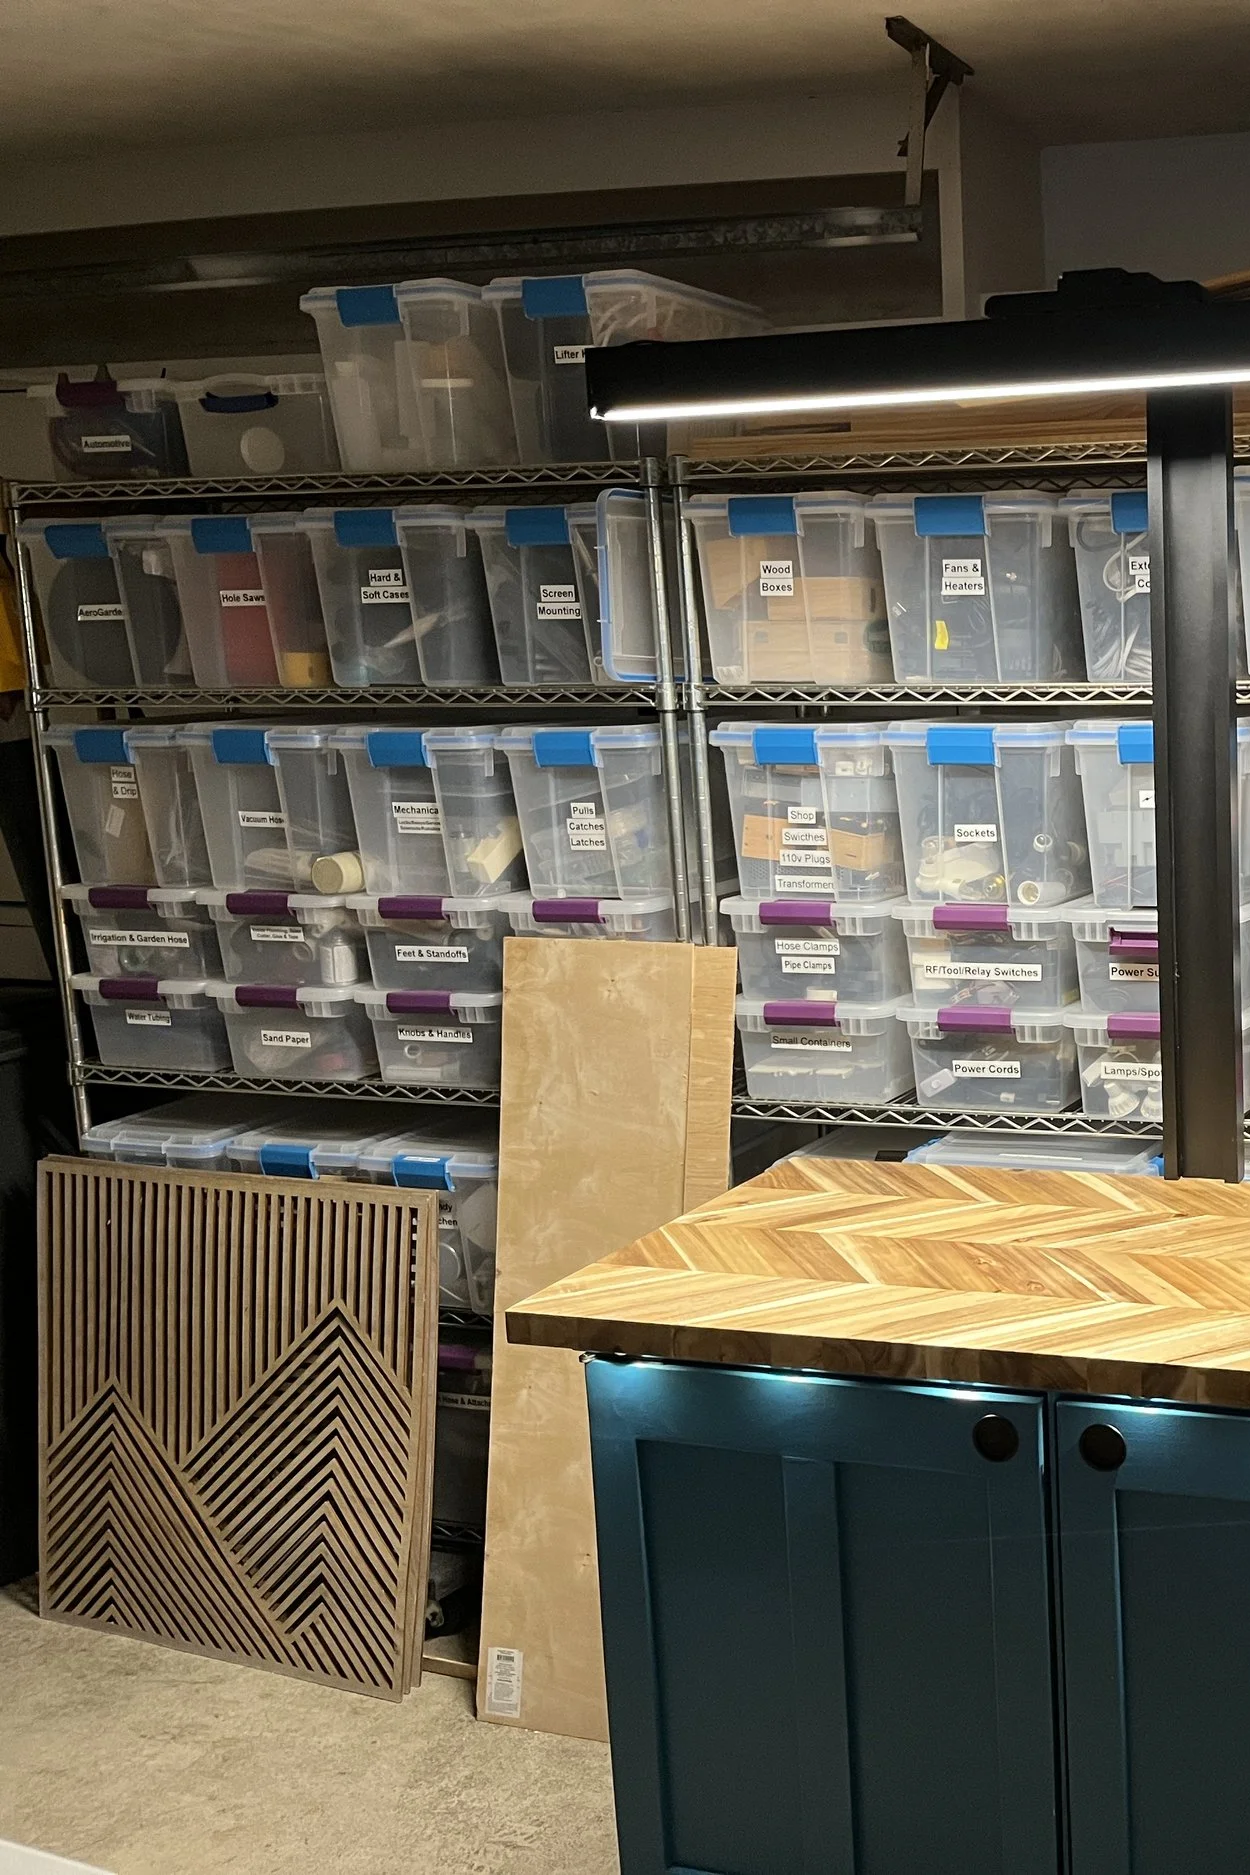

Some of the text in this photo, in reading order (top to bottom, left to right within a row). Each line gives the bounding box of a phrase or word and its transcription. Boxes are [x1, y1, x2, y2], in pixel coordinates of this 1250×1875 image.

[555, 350, 579, 360] Lifter
[83, 438, 131, 449] Automotive
[761, 564, 791, 574] Wood
[944, 563, 980, 573] Fans &
[369, 572, 402, 582] Hard &
[761, 582, 793, 592] Boxes
[944, 581, 984, 591] Heaters
[221, 592, 265, 604] Hole Saws
[362, 589, 410, 600] Soft Cases
[541, 588, 574, 599] Screen
[78, 607, 123, 618] AeroGarde
[538, 606, 581, 617] Mounting
[113, 786, 120, 796] &
[393, 805, 439, 815] Mechanica
[572, 806, 594, 815] Pulls
[241, 814, 268, 824] Vacuum
[790, 810, 815, 822] Shop
[569, 822, 605, 831] Catches
[784, 831, 825, 842] Swicthes
[956, 828, 996, 838] Sockets
[570, 838, 605, 847] Latches
[782, 853, 831, 865] 110v Plugs
[91, 932, 188, 945] Irrigation & Garden Hose
[776, 941, 839, 952] Hose Clamps
[397, 948, 467, 959] Feet & Standoffs
[784, 960, 833, 971] Pipe Clamps
[925, 965, 1039, 978] RF/Tool/Relay Switches
[1111, 966, 1144, 977] Power
[128, 1011, 171, 1025] Water Tubing
[398, 1027, 472, 1039] Knobs & Handles
[262, 1033, 310, 1046] Sand Paper
[772, 1035, 851, 1048] Small Containers
[954, 1064, 1020, 1075] Power Cords
[1104, 1065, 1161, 1079] Lamps/Spo
